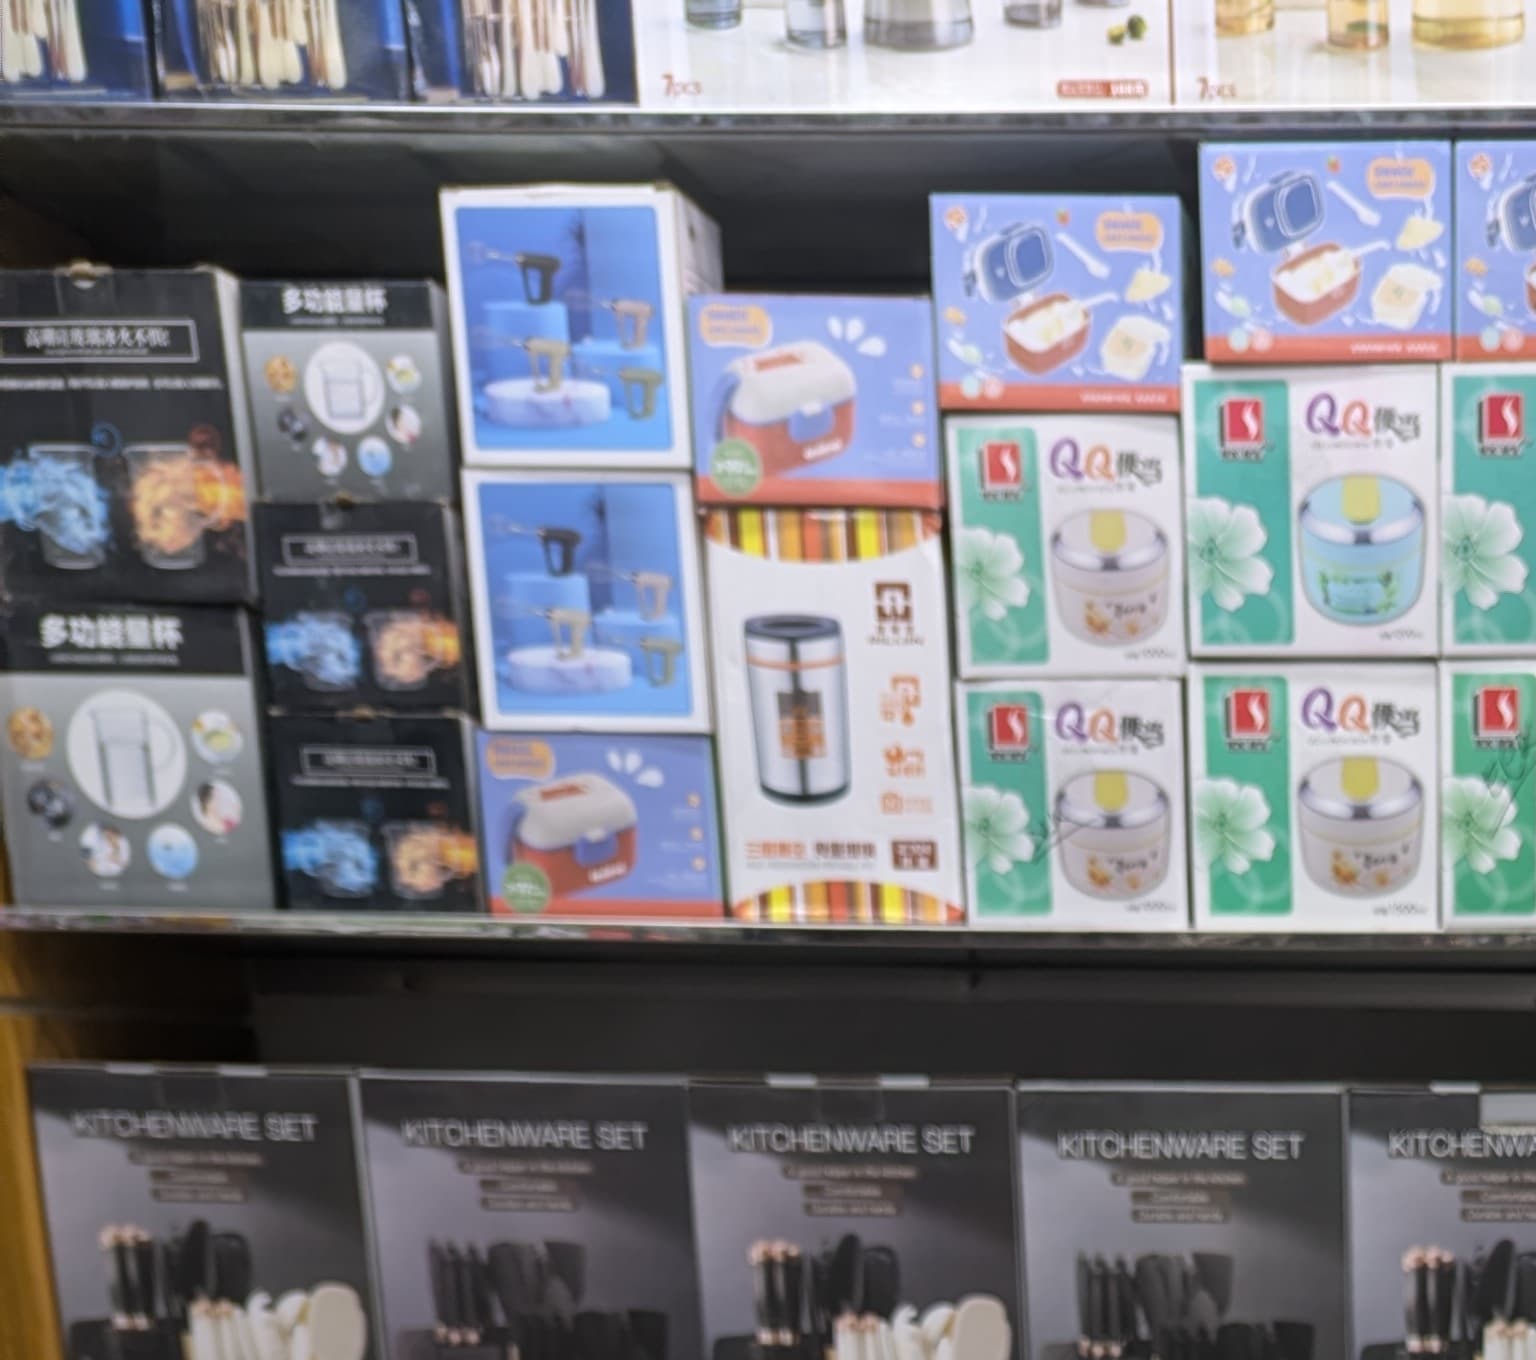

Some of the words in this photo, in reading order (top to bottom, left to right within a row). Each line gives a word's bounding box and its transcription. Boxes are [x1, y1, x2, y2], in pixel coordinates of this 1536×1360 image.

[70, 1110, 264, 1141] KITCHENWARE
[265, 1111, 320, 1142] SET
[403, 1118, 593, 1149] KITCHENWARE
[595, 1120, 649, 1150] SET
[729, 1122, 918, 1153] KITCHENWARE
[922, 1124, 976, 1154] SET
[1056, 1129, 1248, 1160] KITCHENWARE
[1251, 1131, 1305, 1160] SET
